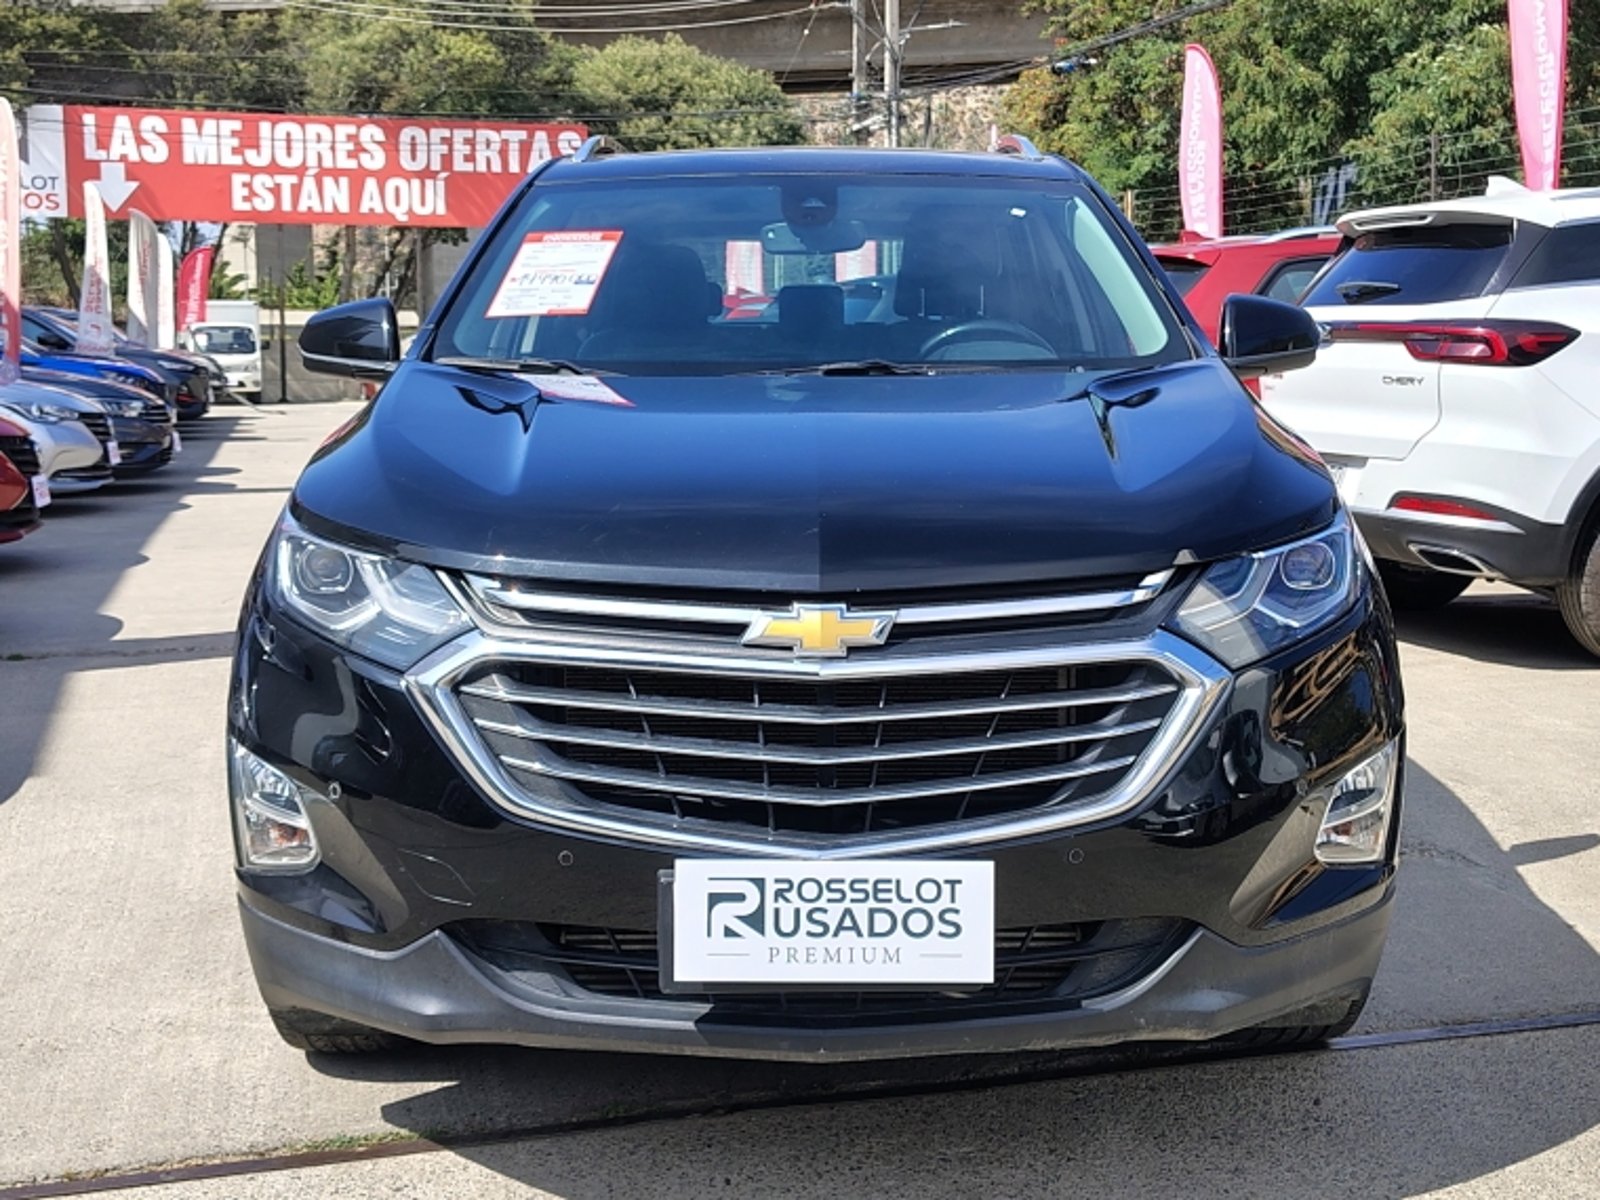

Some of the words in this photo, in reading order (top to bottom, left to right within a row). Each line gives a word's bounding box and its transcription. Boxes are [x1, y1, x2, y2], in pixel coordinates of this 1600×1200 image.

[81, 112, 170, 165] LAS
[180, 117, 387, 172] MEJORES
[399, 125, 584, 174] OFERTAS
[230, 168, 350, 214] ESTÁN
[359, 173, 450, 221] AQUÍ
[1382, 376, 1425, 386] CHERY
[774, 877, 963, 904] ROSSELOT
[774, 907, 963, 939] USADOS
[768, 946, 902, 965] PREMIUM
